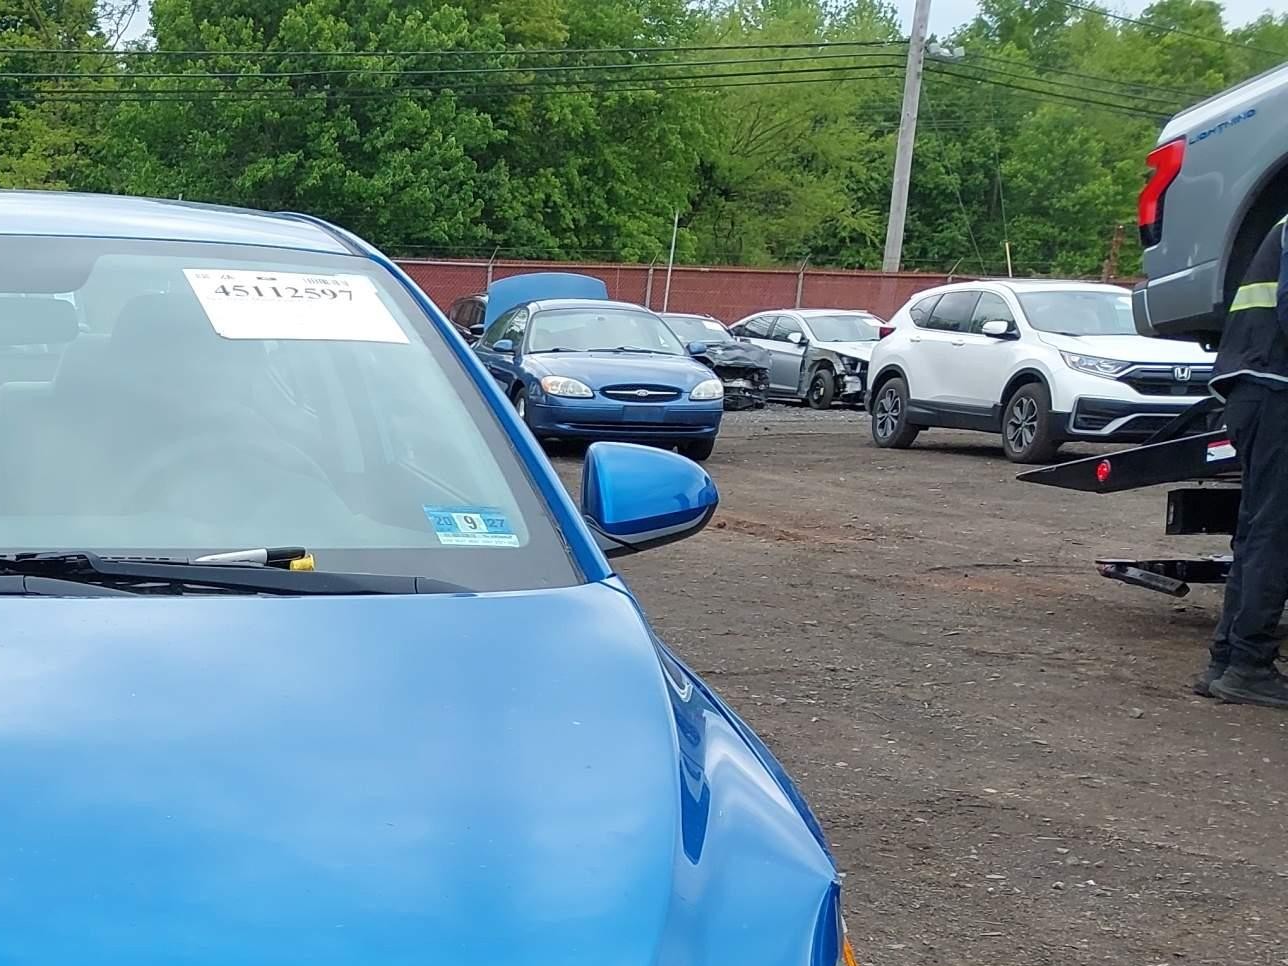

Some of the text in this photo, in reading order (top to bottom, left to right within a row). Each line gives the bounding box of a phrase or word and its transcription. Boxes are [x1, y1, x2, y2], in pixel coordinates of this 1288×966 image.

[214, 283, 353, 301] 45112597
[434, 515, 505, 530] 20 9 27
